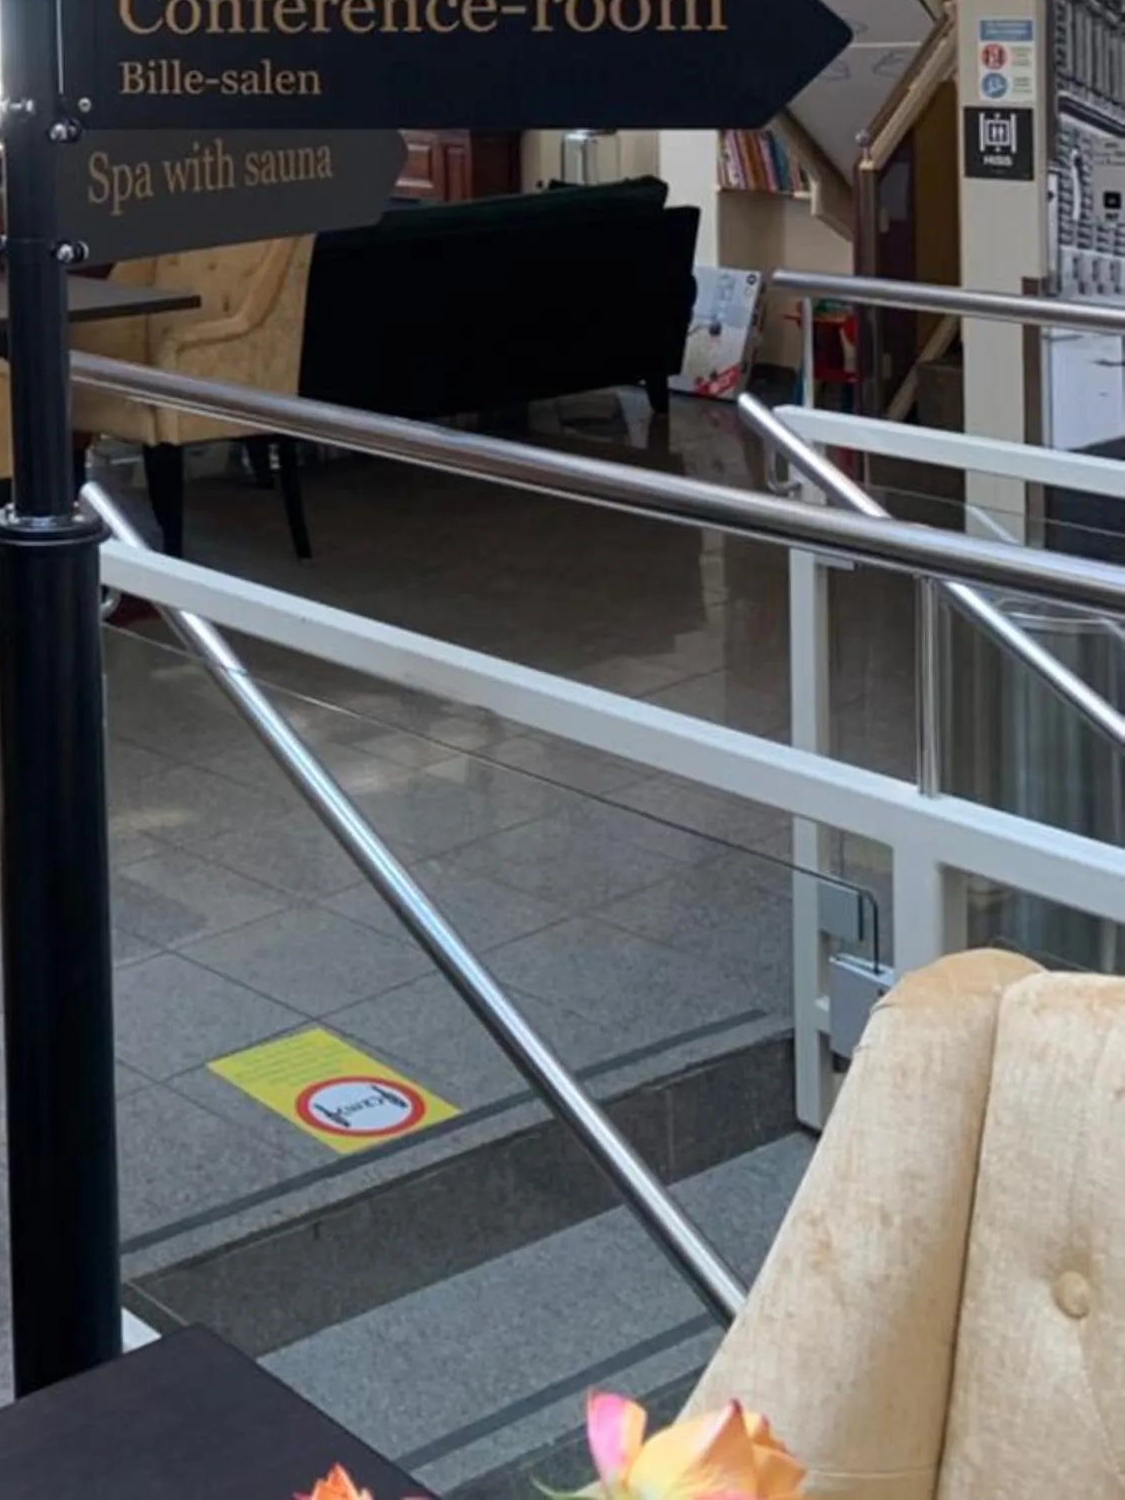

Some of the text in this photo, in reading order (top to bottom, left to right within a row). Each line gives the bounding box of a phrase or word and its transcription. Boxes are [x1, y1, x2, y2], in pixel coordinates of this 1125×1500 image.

[119, 59, 322, 96] Bille-salen
[87, 138, 334, 216] Spa with sauna
